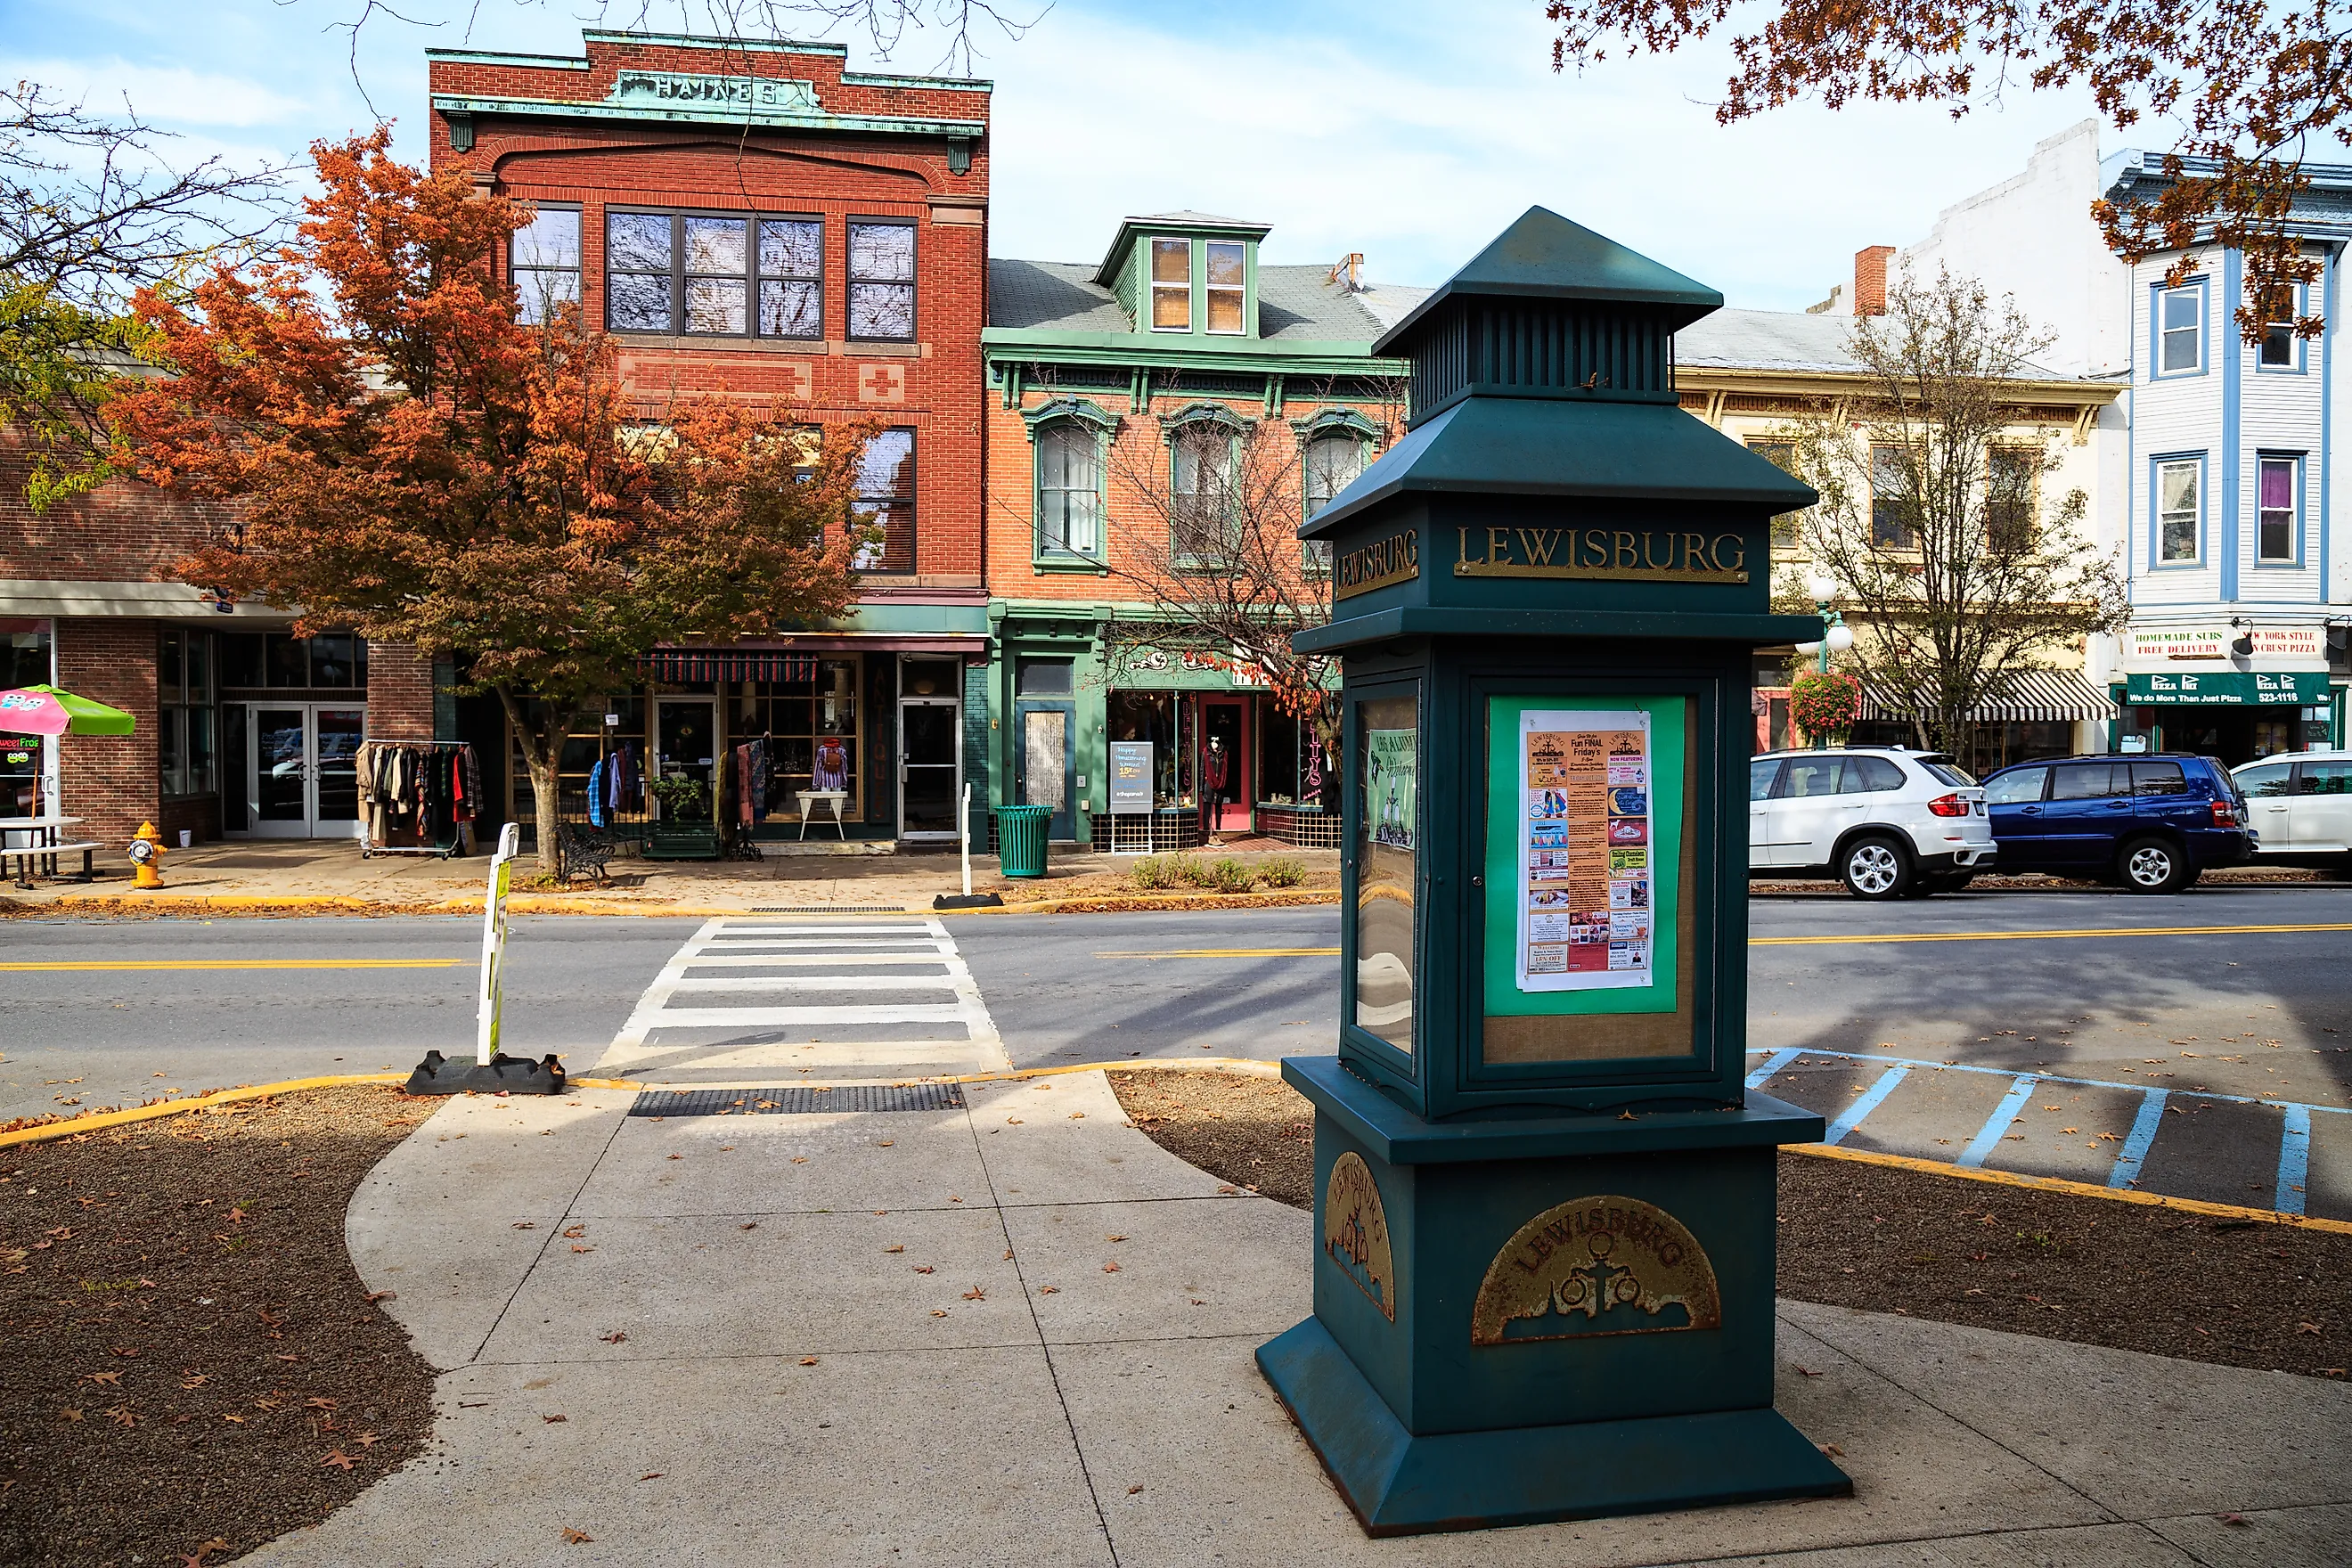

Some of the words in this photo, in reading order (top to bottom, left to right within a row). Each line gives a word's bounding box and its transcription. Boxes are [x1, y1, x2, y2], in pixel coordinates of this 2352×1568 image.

[656, 78, 776, 103] HAINES
[1456, 527, 1745, 572] LEWISBURG
[1336, 528, 1417, 590] LEWISBURG
[2136, 633, 2193, 642] HOMEMADE
[2196, 631, 2223, 641] SUBS
[2265, 632, 2286, 640] YORK
[2289, 632, 2315, 641] STYLE
[2138, 645, 2164, 654] FREE
[2168, 644, 2218, 654] DELIVERY
[2261, 644, 2287, 653] CRUST
[2290, 644, 2315, 653] PIZZA
[2129, 694, 2143, 702] We
[2144, 694, 2154, 702] do
[2156, 694, 2176, 702] More
[2177, 695, 2200, 703] Than
[2201, 695, 2219, 703] Just
[2220, 695, 2242, 703] Pizza
[2258, 692, 2299, 703] 523-1116
[873, 670, 886, 819] ANTIQUES
[1531, 732, 1565, 747] LEWISBURG
[1571, 739, 1583, 747] Fun
[1584, 739, 1604, 747] FINAL
[1608, 731, 1642, 746] LEWISBURG
[1573, 747, 1601, 757] Friday's
[1334, 1162, 1382, 1245] LEWISBURG
[1515, 1207, 1683, 1277] LEWISBURG
